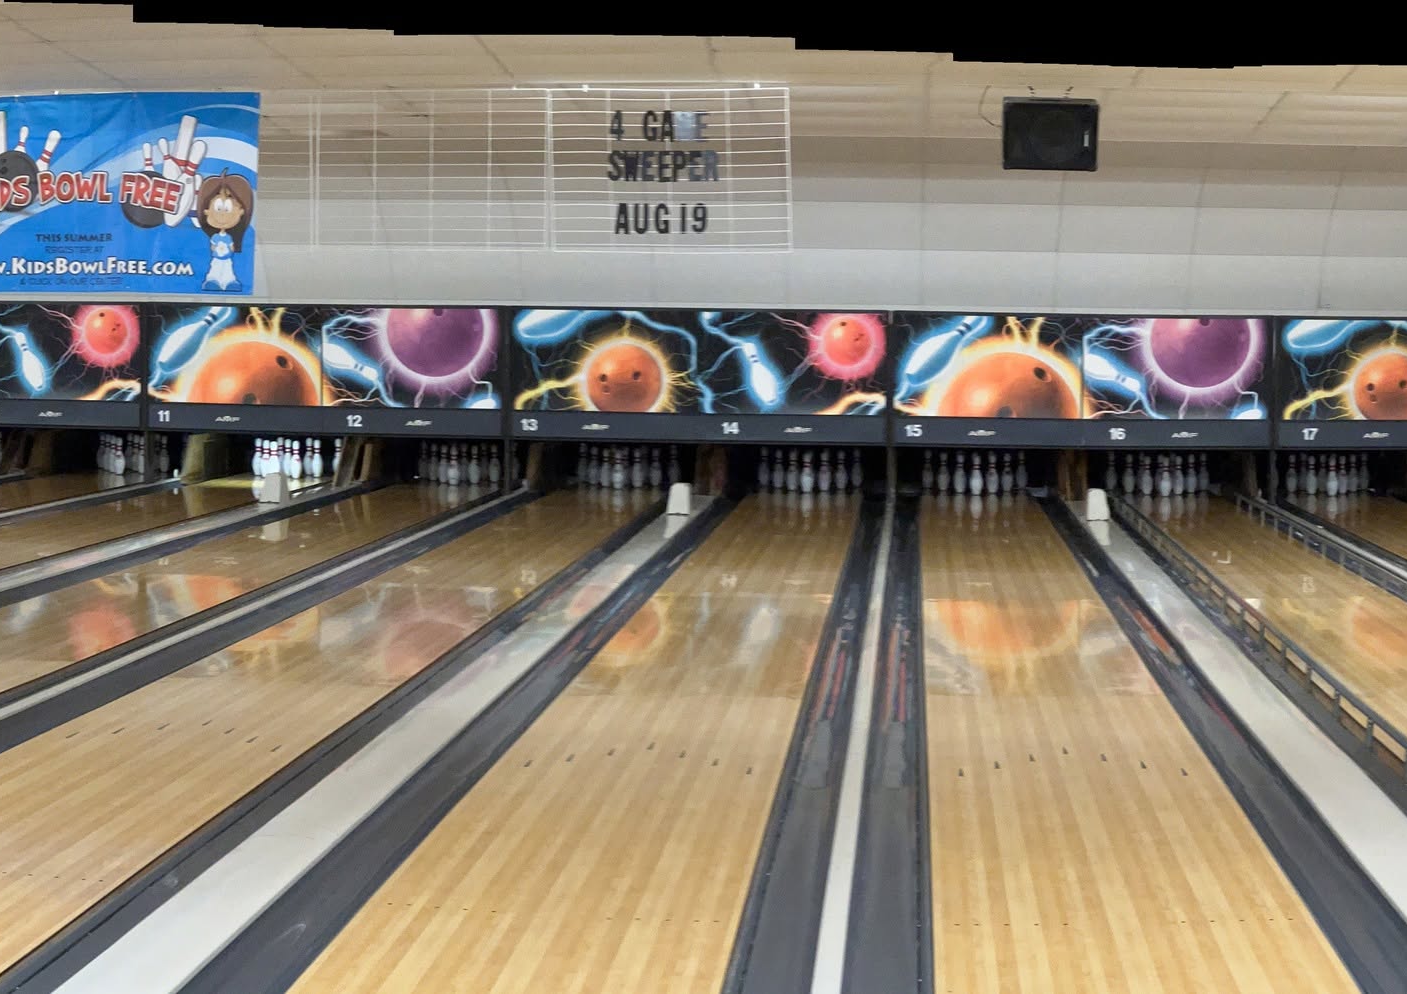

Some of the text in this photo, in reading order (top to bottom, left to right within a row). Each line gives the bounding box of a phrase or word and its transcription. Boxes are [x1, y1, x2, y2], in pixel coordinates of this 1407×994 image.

[610, 110, 708, 142] 4 GAE
[608, 150, 718, 182] SWEEPER
[37, 171, 112, 204] BOWL
[119, 172, 185, 214] FREE
[614, 203, 708, 234] AUG 19
[36, 232, 112, 243] THIS SUMMER
[157, 409, 171, 422] 11
[346, 414, 363, 428] 12
[520, 418, 539, 431] 13
[721, 421, 740, 435] 14
[904, 424, 923, 437] 15
[1108, 427, 1126, 440] 16
[1301, 427, 1319, 441] 17
